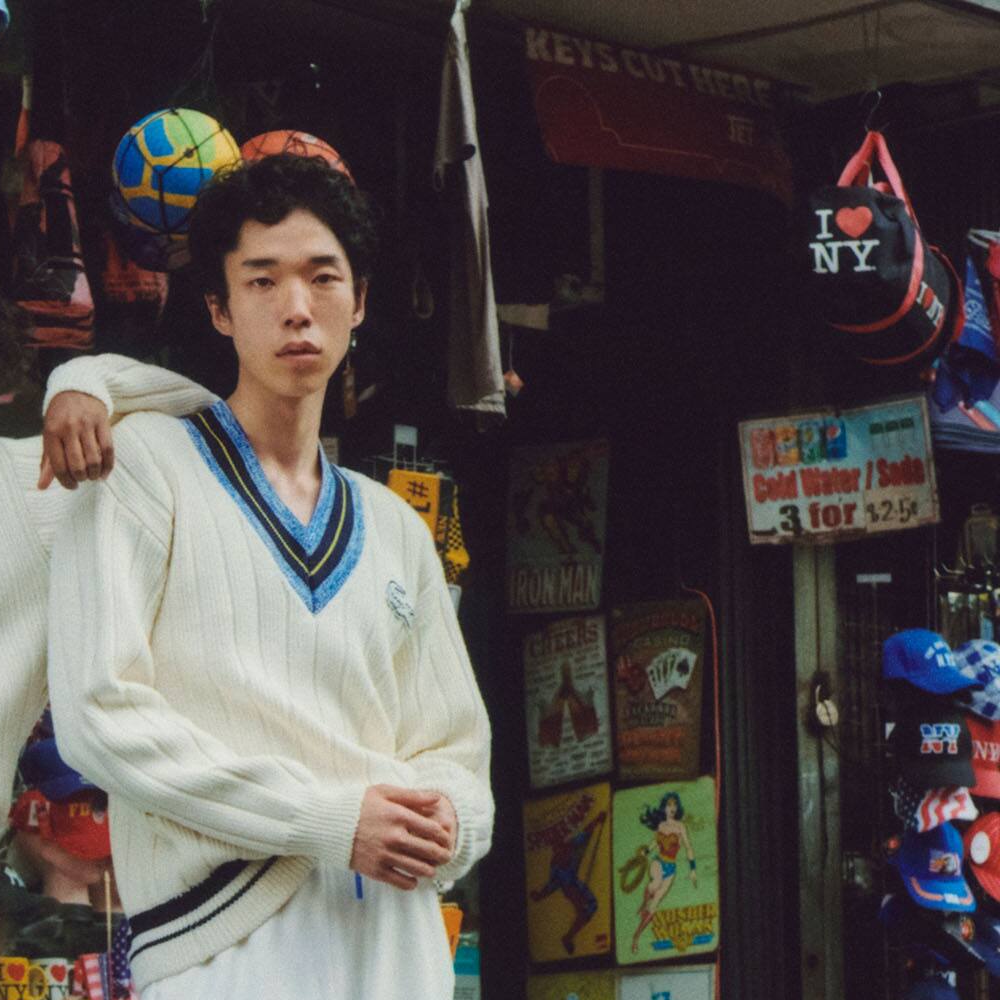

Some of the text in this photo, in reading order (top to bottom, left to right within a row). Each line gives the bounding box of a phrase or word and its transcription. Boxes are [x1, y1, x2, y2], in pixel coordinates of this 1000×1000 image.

[524, 27, 772, 111] KEYS CUT HERE
[814, 209, 834, 240] I
[809, 239, 880, 274] NY
[752, 470, 799, 504] Cold
[799, 465, 861, 497] Water
[876, 453, 926, 488] Soda
[779, 503, 800, 537] 3
[808, 501, 857, 529] for
[508, 563, 601, 607] IRON MAN
[528, 617, 599, 656] CHEERS
[920, 723, 961, 754] NY
